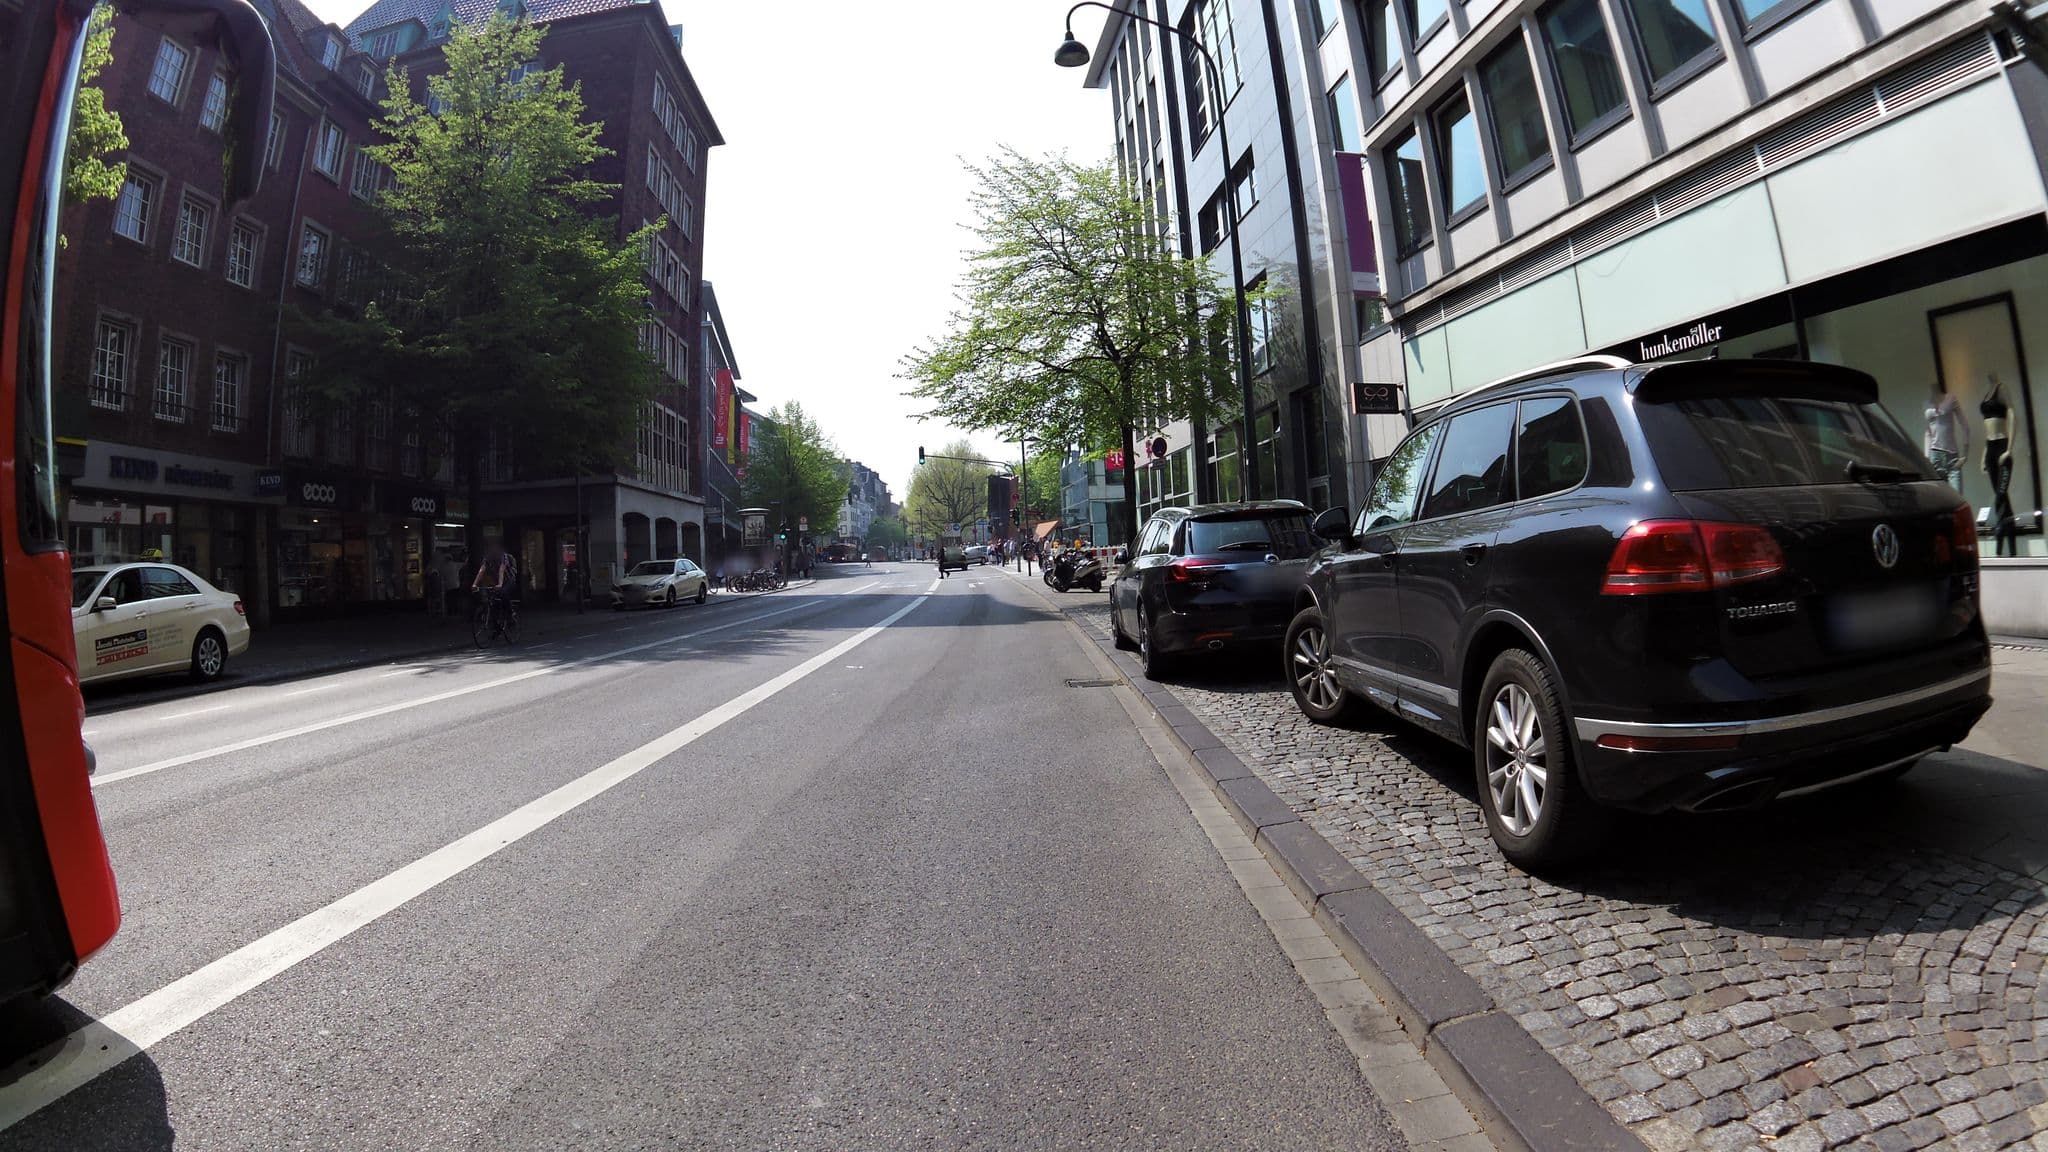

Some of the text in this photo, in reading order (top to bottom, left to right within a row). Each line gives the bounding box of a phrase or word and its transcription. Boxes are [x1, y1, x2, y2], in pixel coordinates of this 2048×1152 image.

[1640, 322, 1722, 361] hunkemöller
[303, 482, 336, 503] ecco
[411, 497, 436, 513] ecco
[1726, 601, 1797, 619] TOUAREG
